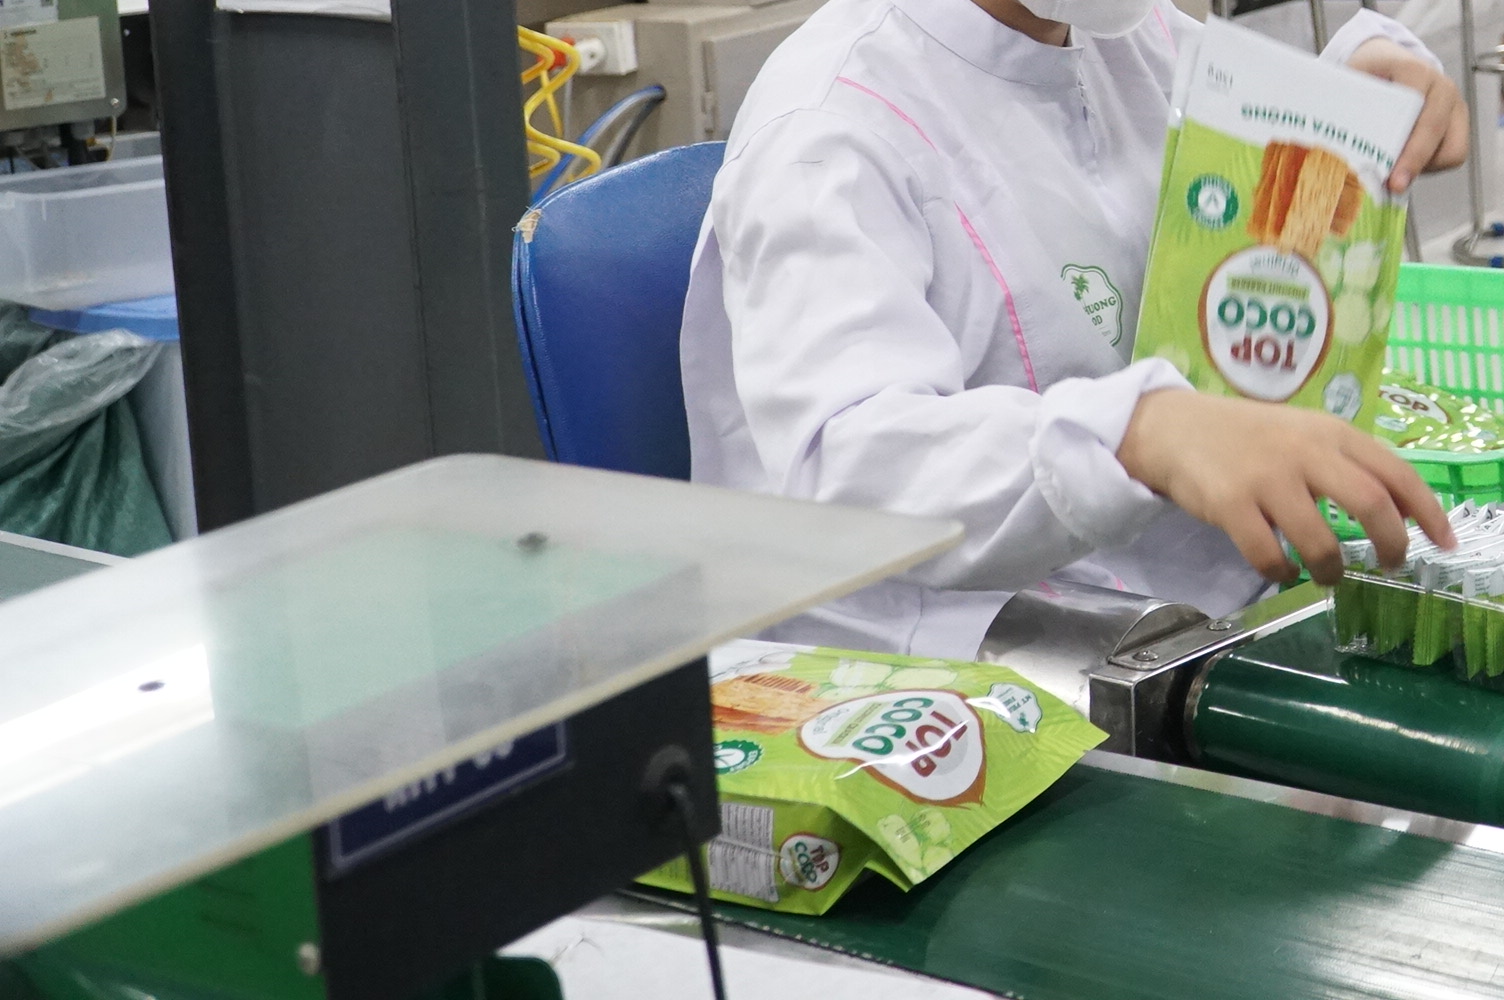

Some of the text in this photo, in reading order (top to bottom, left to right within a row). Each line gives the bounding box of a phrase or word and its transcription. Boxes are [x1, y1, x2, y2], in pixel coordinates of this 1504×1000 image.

[1217, 295, 1317, 339] COCO
[1231, 334, 1297, 374] TOP
[852, 697, 934, 755] COCO
[905, 710, 968, 777] TOP
